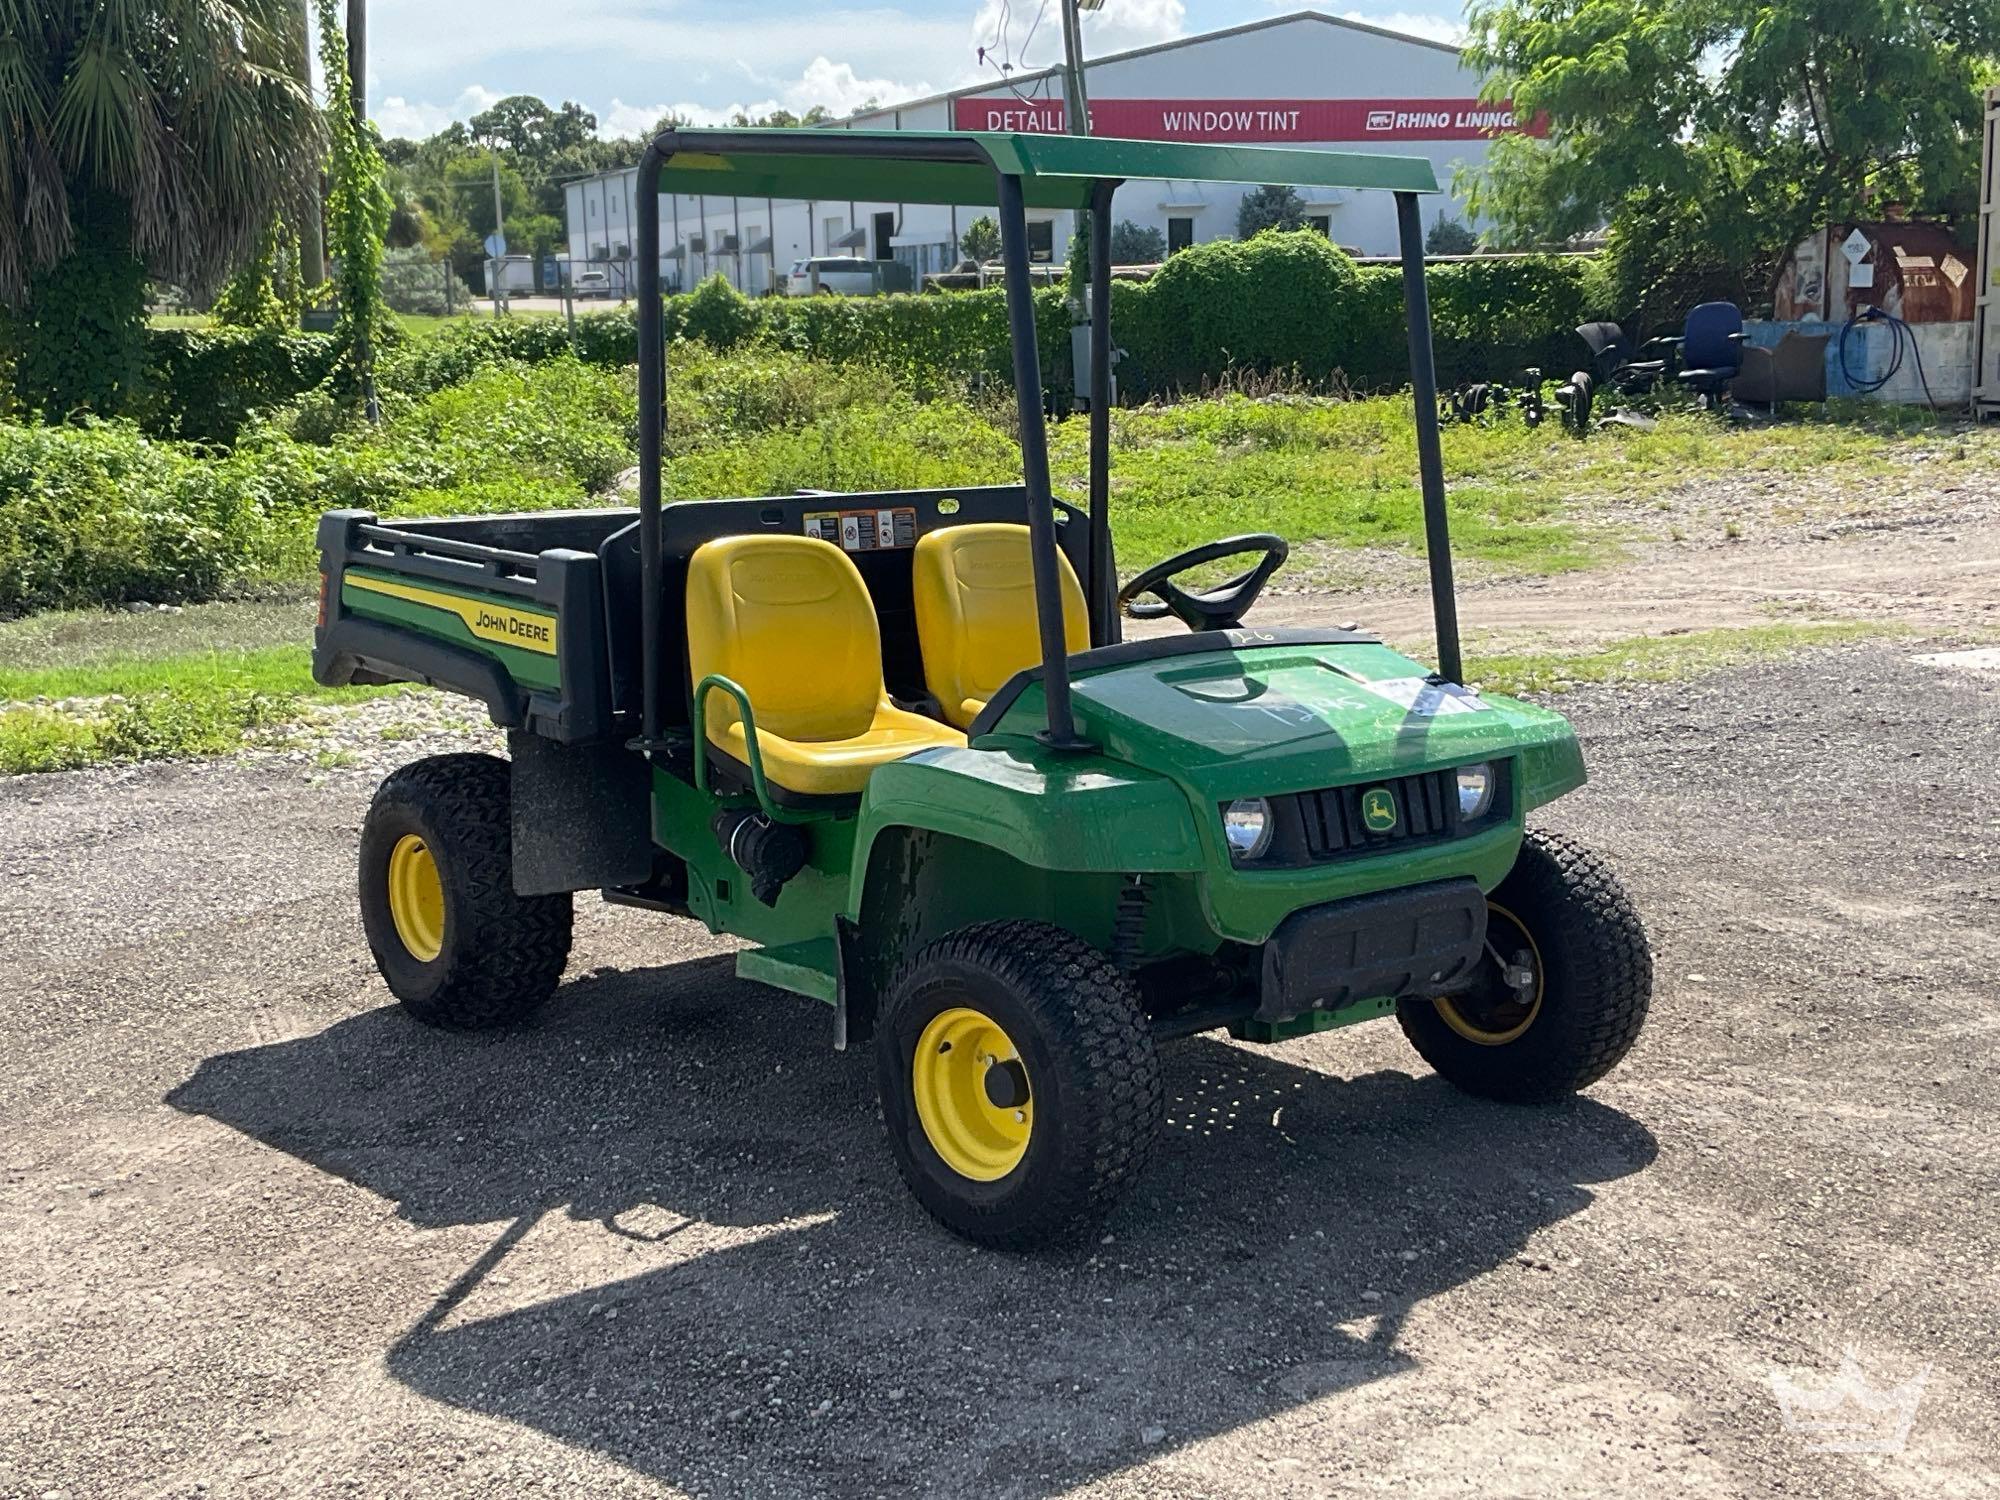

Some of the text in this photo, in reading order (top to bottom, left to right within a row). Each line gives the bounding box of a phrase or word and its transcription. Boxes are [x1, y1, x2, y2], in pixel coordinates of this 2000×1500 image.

[1163, 111, 1300, 132] WINDOW TINT
[1395, 112, 1450, 129] RHINO
[475, 610, 549, 643] JOHN DEERE
